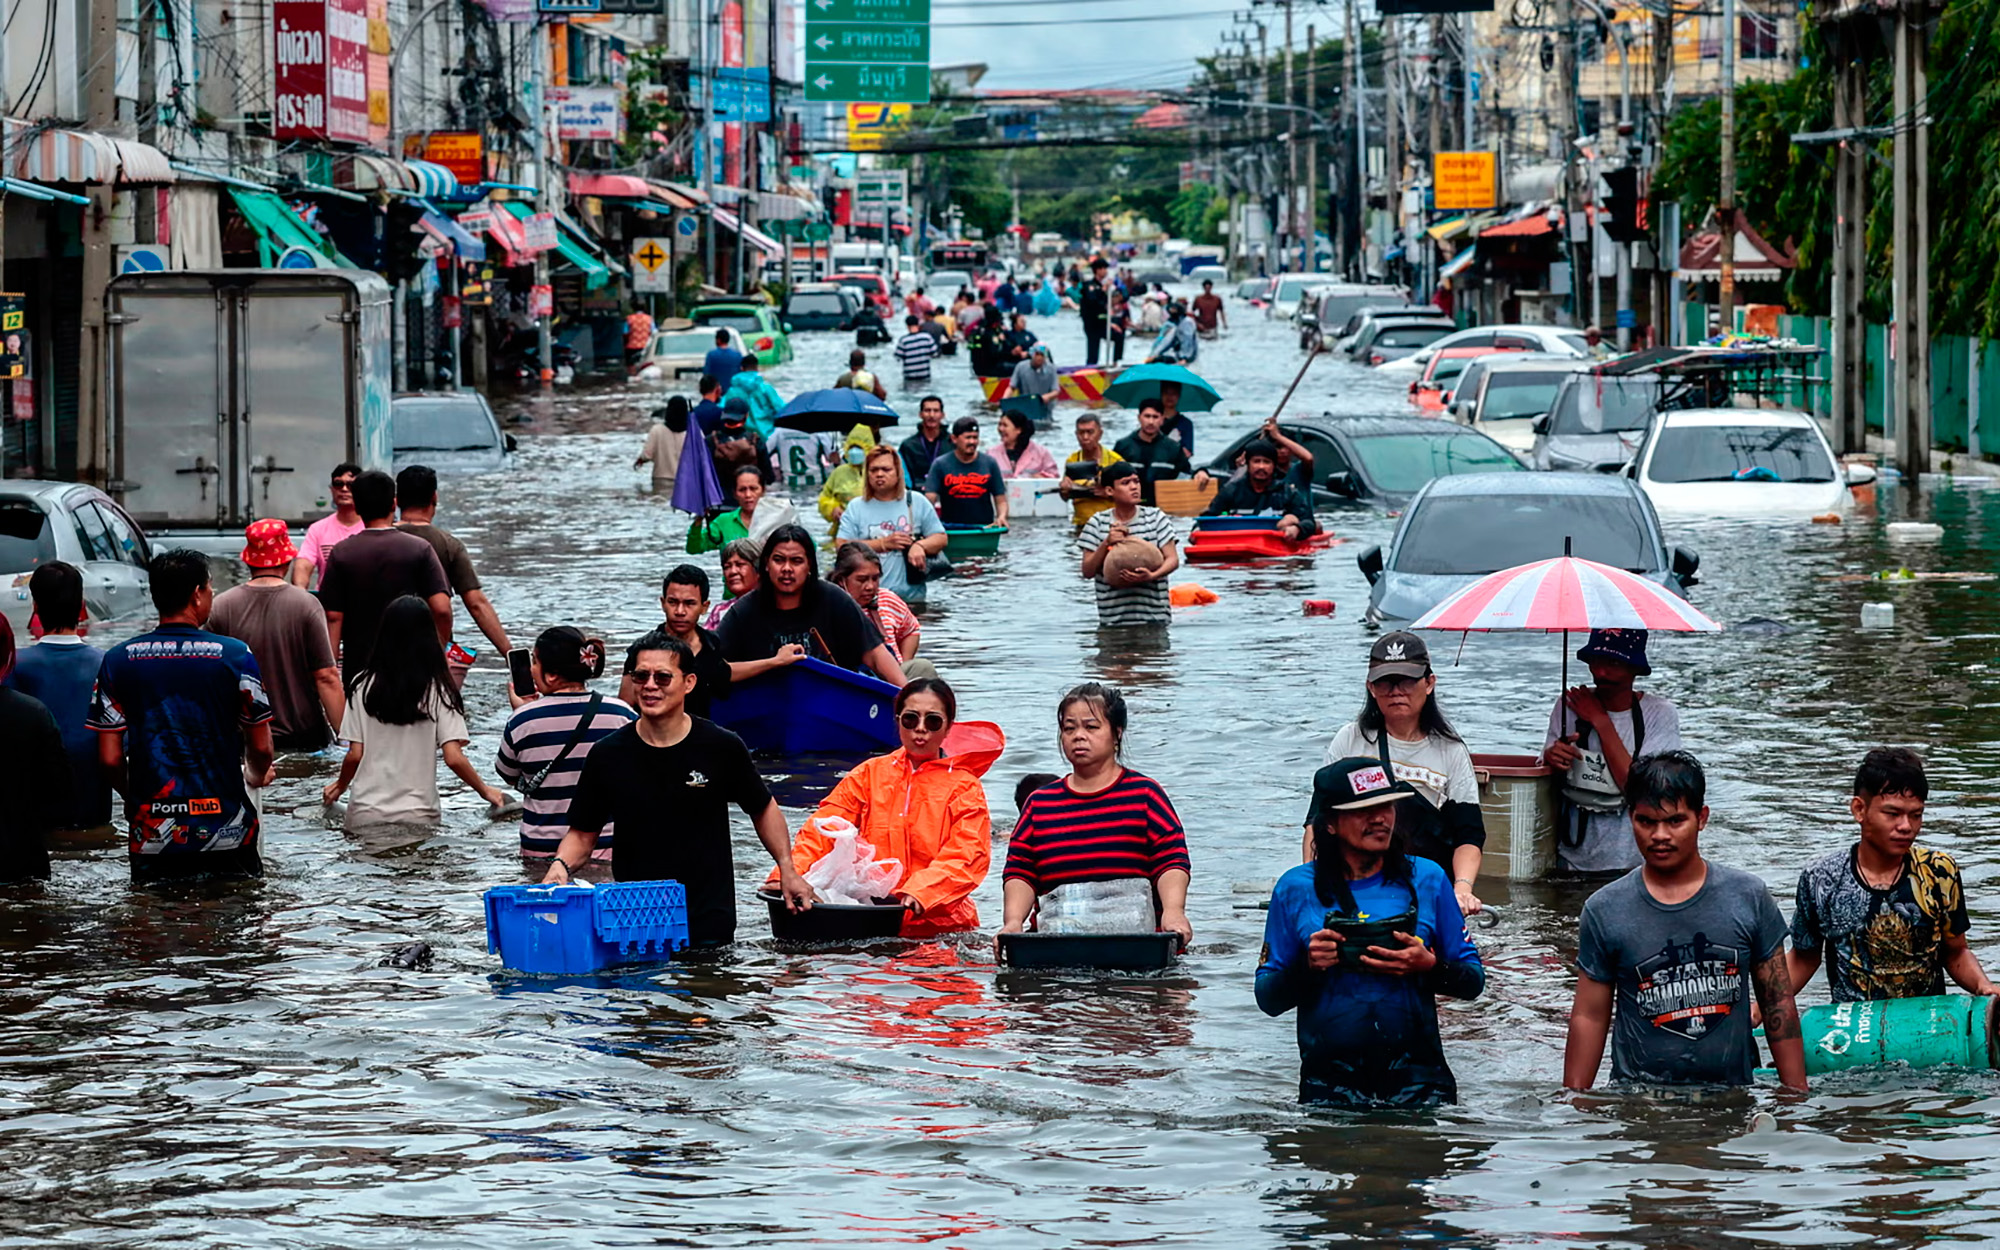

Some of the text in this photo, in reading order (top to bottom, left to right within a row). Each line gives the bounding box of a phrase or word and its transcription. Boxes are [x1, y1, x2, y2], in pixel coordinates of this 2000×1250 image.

[277, 18, 323, 78] มุ้งลวด
[841, 28, 921, 47] ลาดกระบัง
[858, 65, 906, 91] มีนบุรี
[278, 93, 323, 128] กระจก
[7, 314, 21, 328] 12
[789, 446, 809, 476] 6
